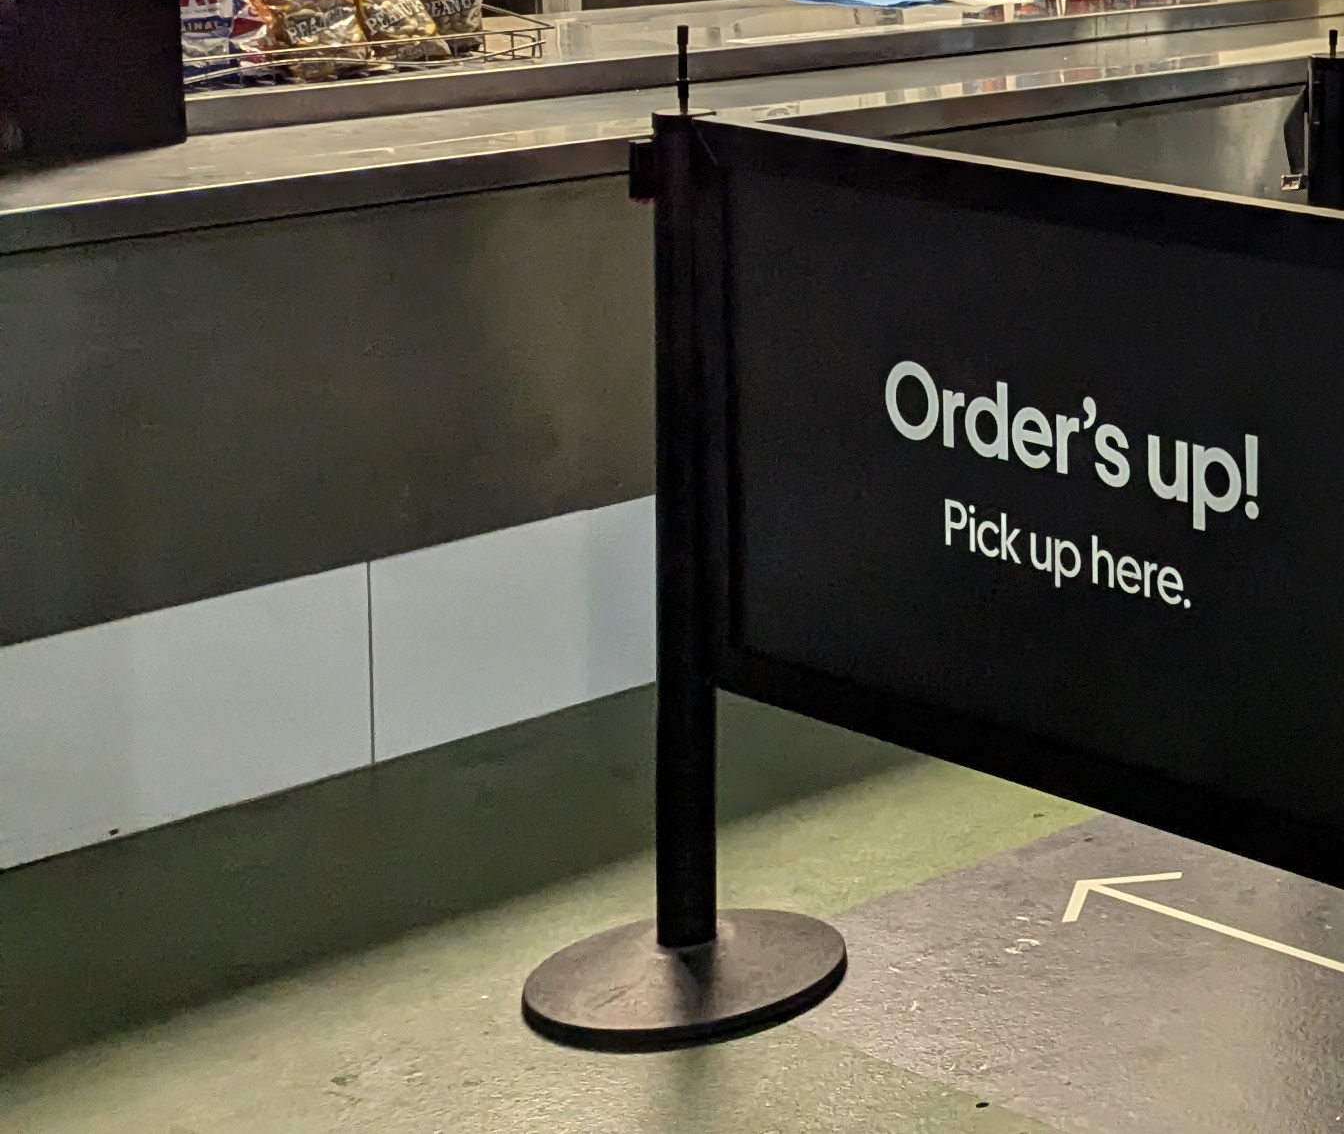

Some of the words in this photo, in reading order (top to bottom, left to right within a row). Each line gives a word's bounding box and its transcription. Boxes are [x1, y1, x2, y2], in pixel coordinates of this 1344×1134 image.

[885, 360, 1131, 488] Order's
[1148, 433, 1259, 531] up!
[944, 498, 1021, 565] Pick
[1030, 531, 1081, 588] up
[1091, 535, 1191, 609] here.
